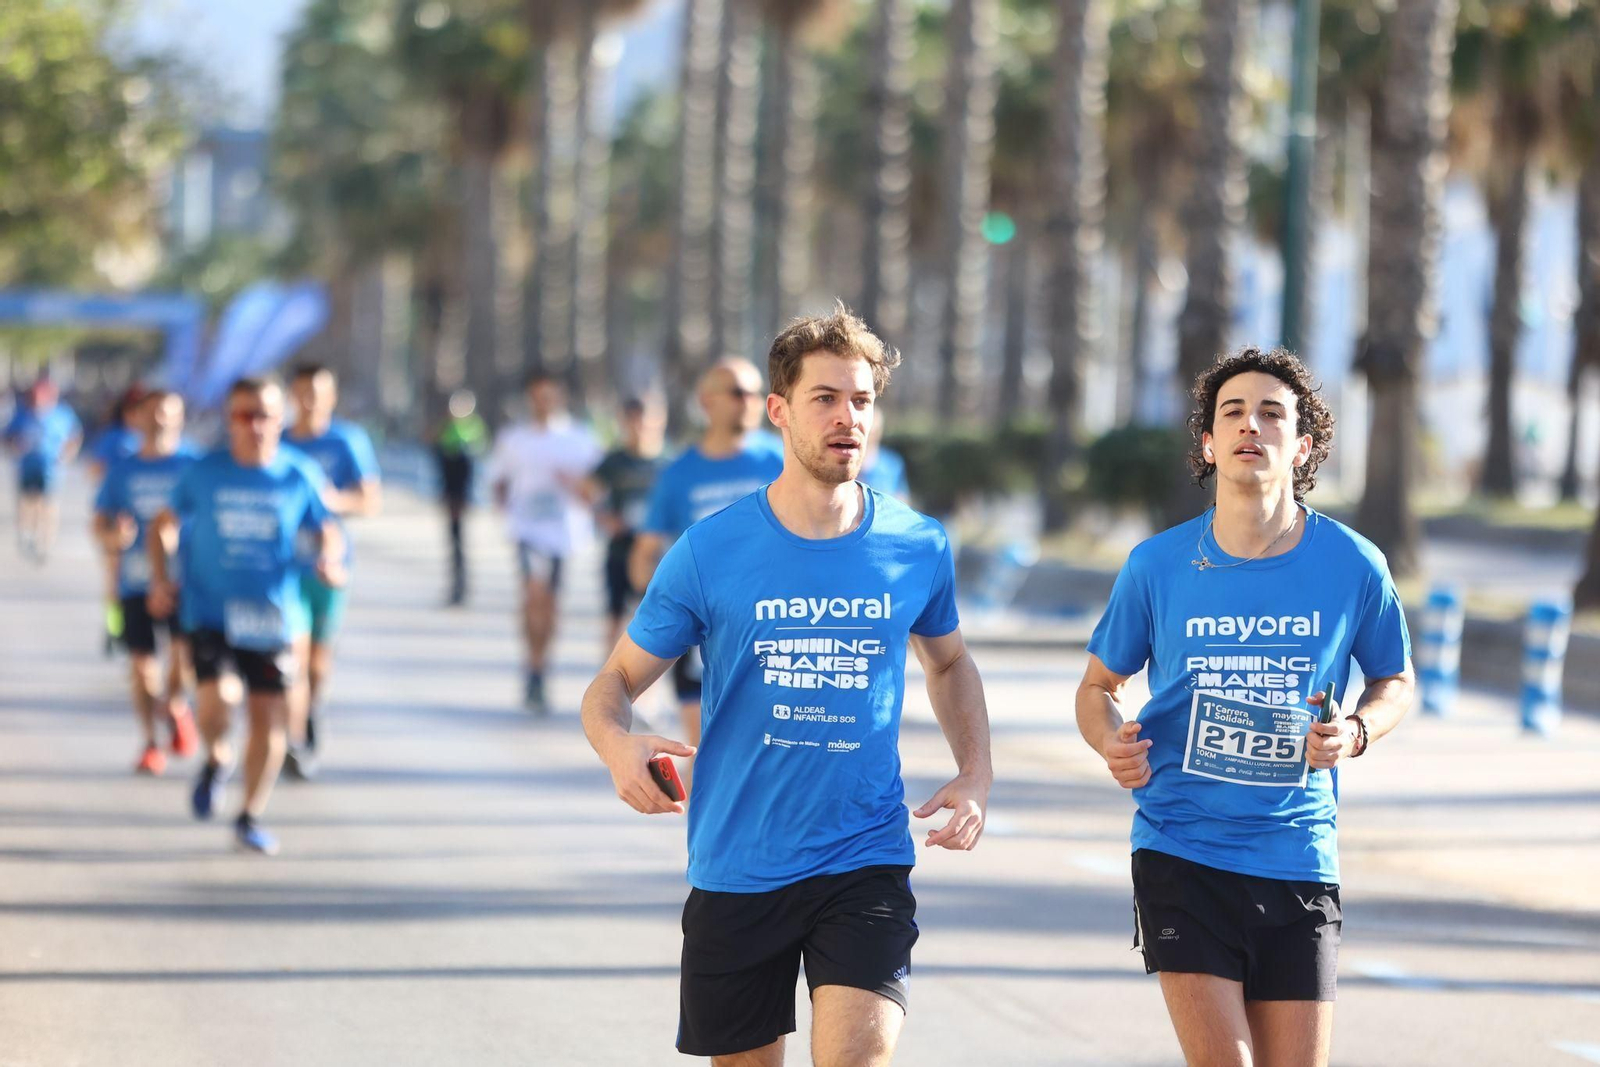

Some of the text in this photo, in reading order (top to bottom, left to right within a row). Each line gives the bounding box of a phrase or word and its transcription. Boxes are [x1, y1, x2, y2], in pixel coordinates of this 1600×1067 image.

[755, 592, 892, 626] mayoral
[1186, 610, 1321, 643] mayoral
[754, 638, 881, 656] RUNNING
[767, 655, 869, 672] MAKES
[1186, 656, 1311, 672] RUNNING
[764, 669, 869, 690] FRIENDS
[1198, 673, 1300, 688] MAKES
[793, 706, 826, 714] ALDEAS
[1215, 704, 1249, 719] Carrera
[1272, 711, 1309, 722] mayoral
[793, 713, 856, 724] INFANTILES SOS
[1214, 712, 1255, 727] Solidaria
[1203, 725, 1296, 760] 2125
[1196, 748, 1217, 760] 10KM
